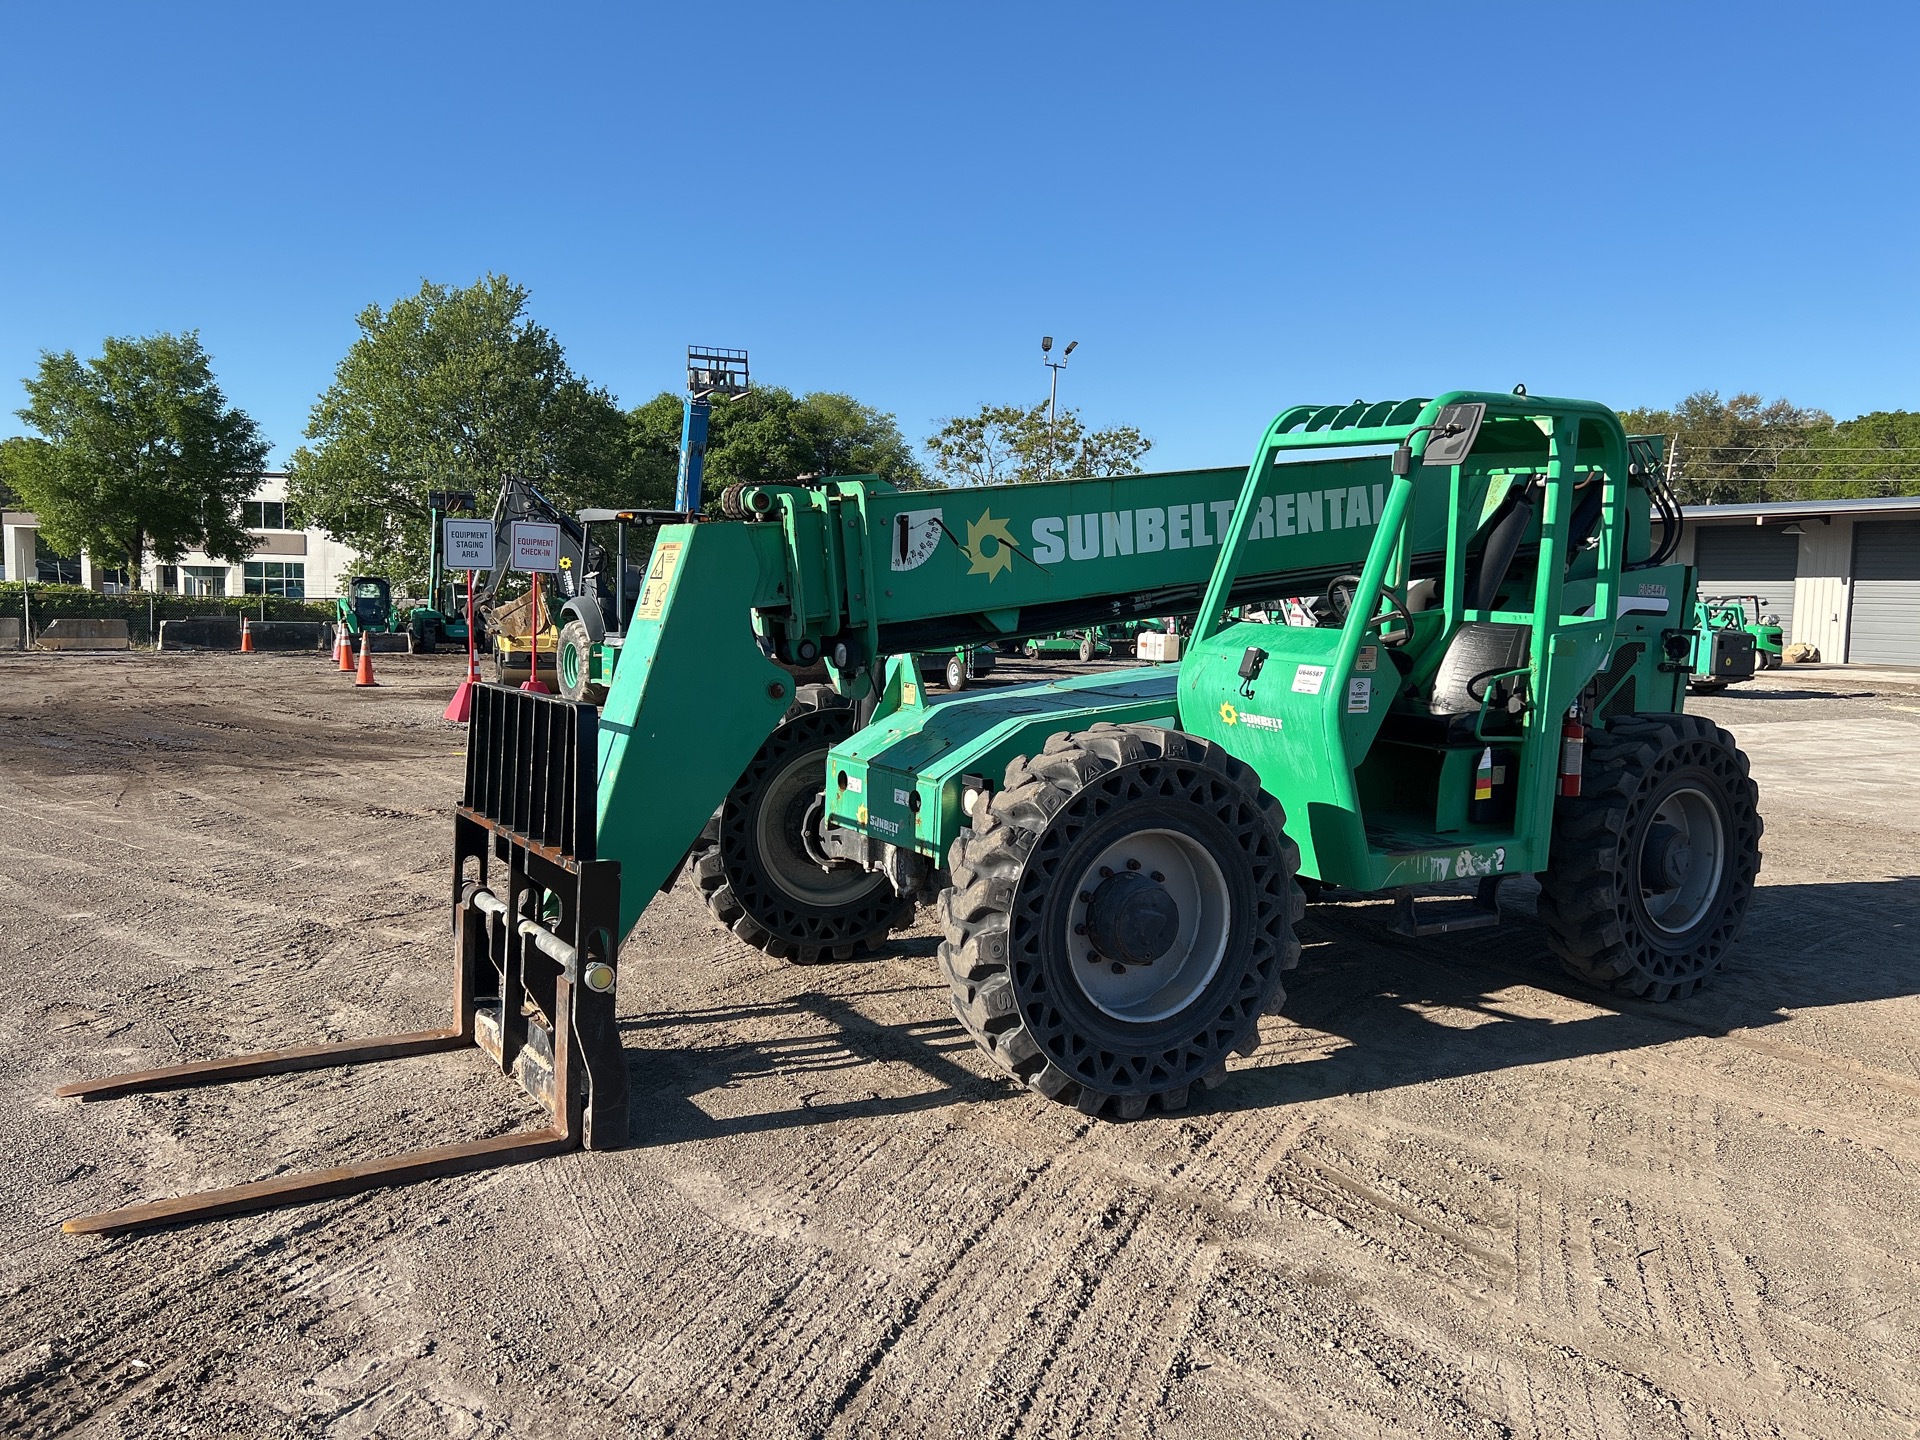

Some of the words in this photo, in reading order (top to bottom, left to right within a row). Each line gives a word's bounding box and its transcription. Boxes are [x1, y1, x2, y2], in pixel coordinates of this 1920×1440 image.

[451, 530, 488, 539] EQUIPMENT
[1031, 500, 1235, 565] SUNBELT
[456, 541, 484, 549] STAGING
[517, 537, 554, 547] EQUIPMENT
[520, 548, 551, 557] CHECK-IN
[1638, 584, 1667, 596] 605447
[1298, 669, 1323, 677] U646587
[1239, 711, 1283, 730] SUNBELT
[1246, 723, 1279, 733] RENTALS
[869, 814, 899, 834] SUNBELT
